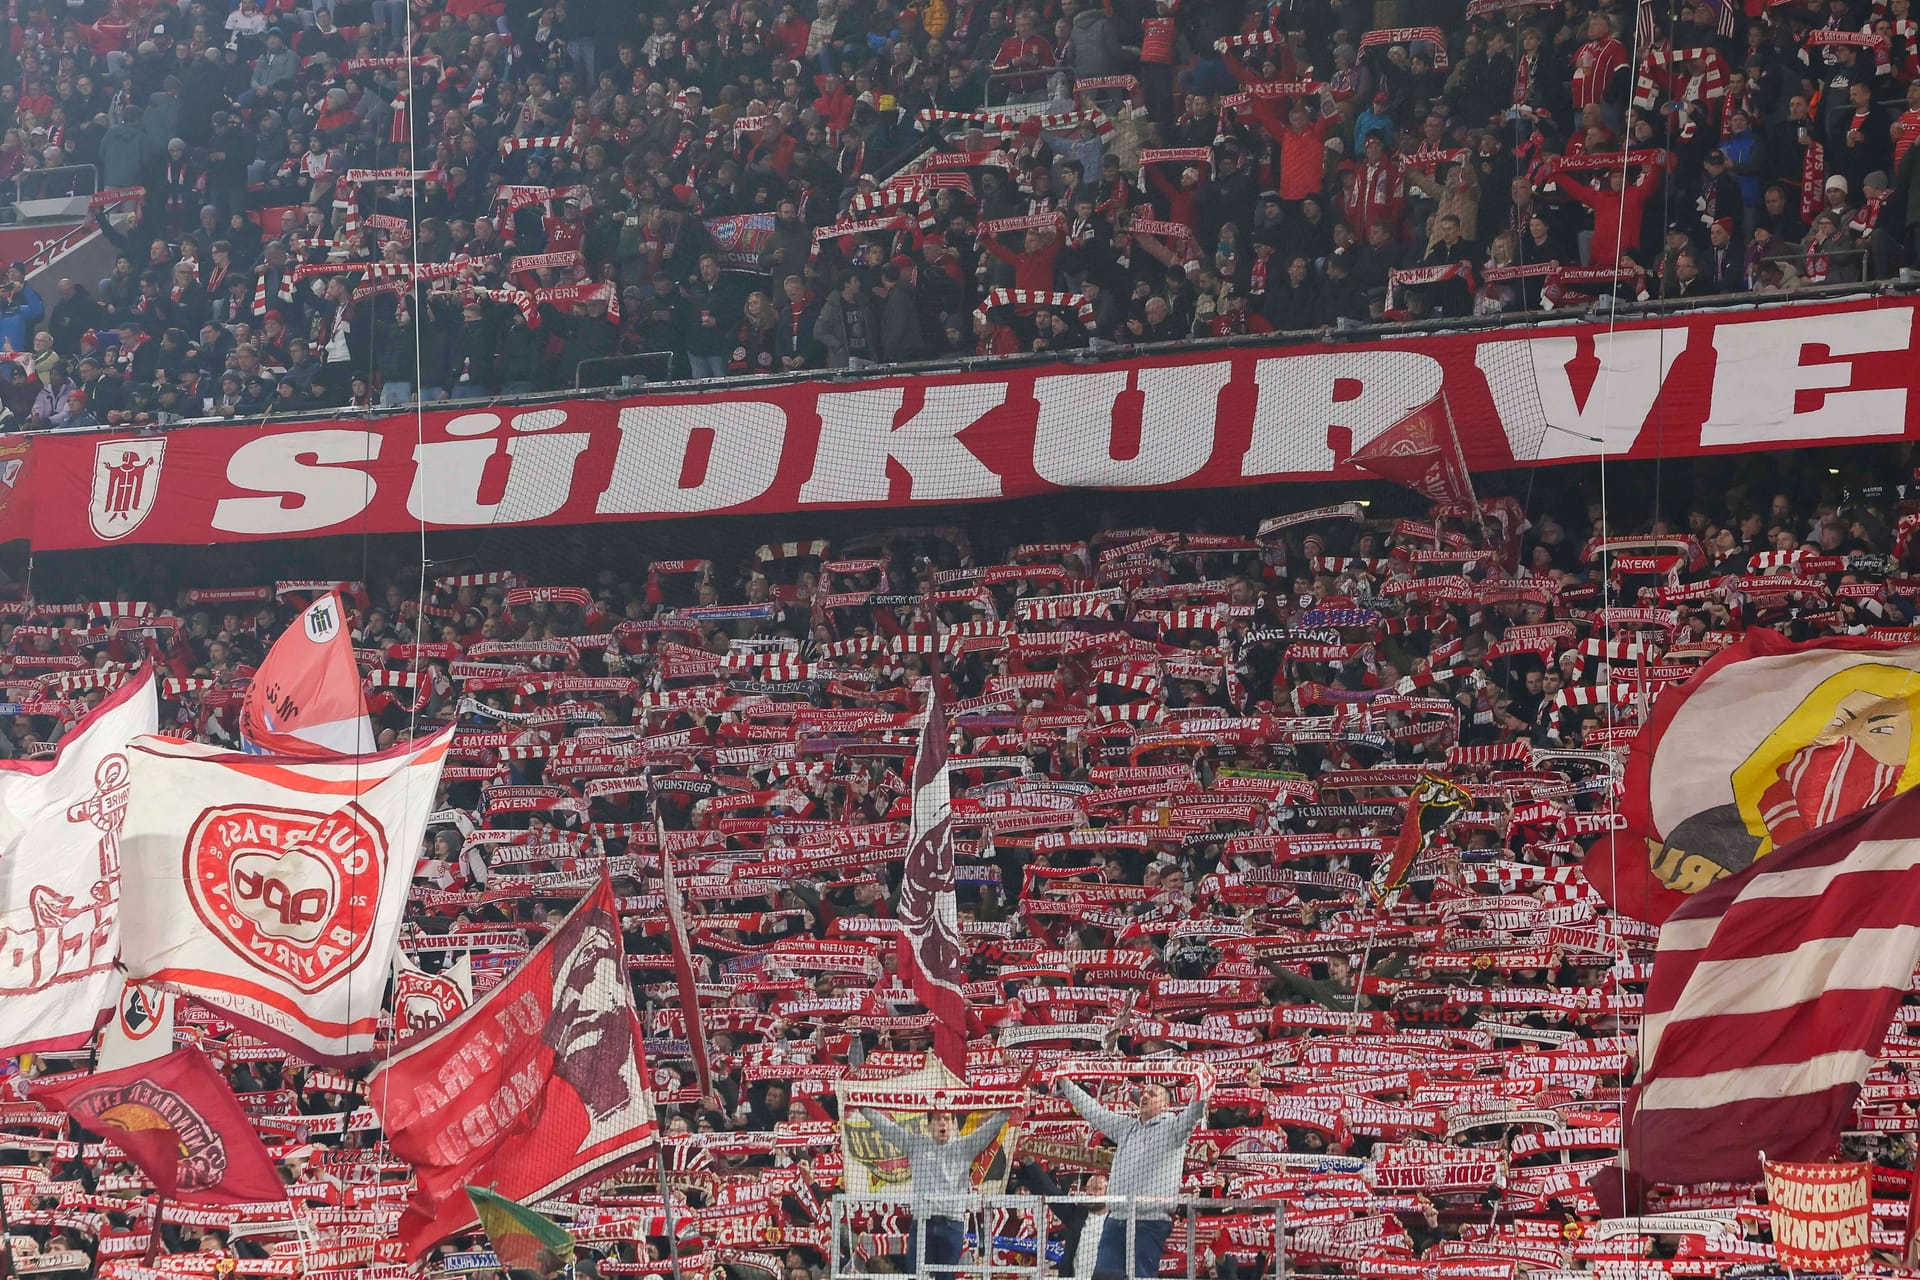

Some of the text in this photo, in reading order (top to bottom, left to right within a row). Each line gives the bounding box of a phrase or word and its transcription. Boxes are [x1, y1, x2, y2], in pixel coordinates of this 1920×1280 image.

[1824, 33, 1849, 41] BAYERN
[348, 60, 365, 70] MIA
[936, 154, 970, 166] BAYERN
[350, 170, 368, 178] MIA
[829, 219, 878, 233] SAN MIA
[211, 304, 1914, 535] SÜDKURVE
[1570, 587, 1595, 597] BAYERN
[38, 604, 83, 614] SAN MIA
[19, 625, 47, 634] SAN
[1292, 645, 1348, 658] SAN MIA
[15, 655, 45, 664] BAYERN
[566, 680, 593, 688] BAYERN
[857, 714, 894, 727] BAYERN
[1597, 729, 1638, 739] BAYERN
[461, 735, 506, 745] BAYERN
[1333, 773, 1367, 783] BAYERN
[601, 777, 642, 791] SAN MIA
[1232, 779, 1269, 789] BAYERN
[491, 799, 537, 810] BAYERN
[716, 795, 754, 808] BAYERN
[1298, 805, 1396, 817] FC BAYERN MÜNCHEN
[1513, 808, 1540, 822] SAN
[997, 817, 1030, 828] BAYERN
[466, 832, 506, 843] SAN MIA
[1035, 829, 1148, 848] FÜR MÜNCHEN
[1234, 838, 1245, 849] FC
[769, 848, 796, 860] FÜR
[795, 855, 857, 871] FC BAYERN
[738, 865, 783, 877] BAYERN
[1087, 889, 1147, 900] SAN MIA
[1486, 897, 1538, 908] Supporters
[819, 943, 868, 955] FC BAYERN
[1036, 950, 1108, 965] SÜDKURVE
[886, 991, 909, 1001] MIA
[1874, 1119, 1900, 1130] WIR
[1878, 1176, 1906, 1185] BAYERN
[1766, 1176, 1868, 1213] SCHICKERIA
[162, 1207, 239, 1226] MÜNCHEN
[1772, 1211, 1868, 1251] MÜNCHEN
[236, 1260, 293, 1274] KERIA
